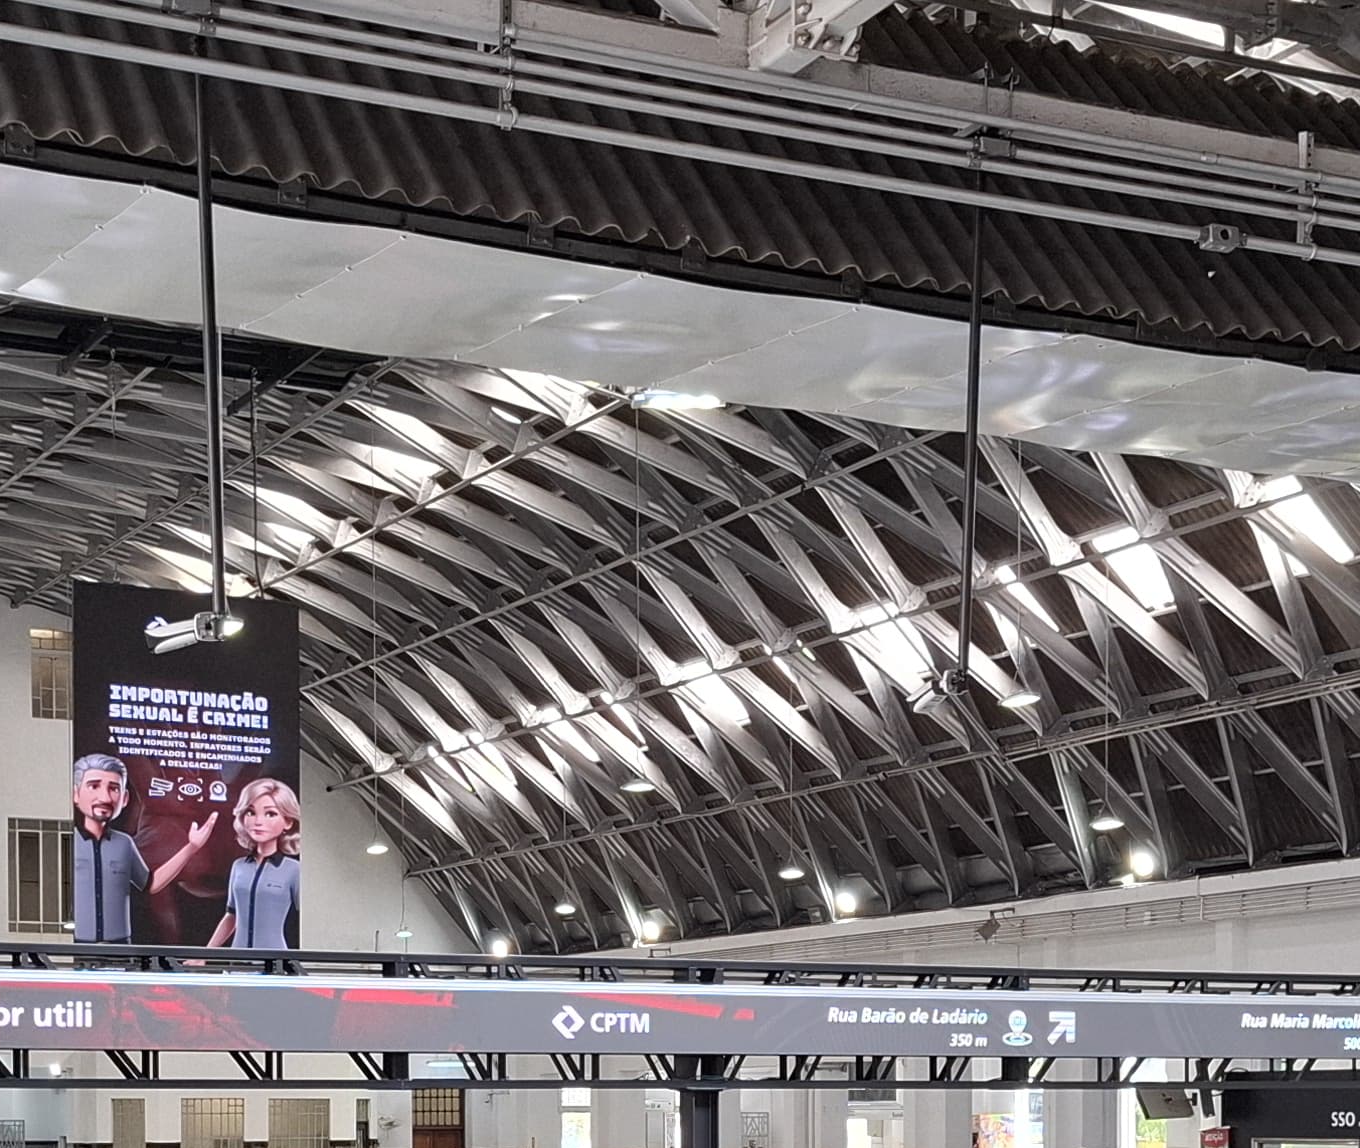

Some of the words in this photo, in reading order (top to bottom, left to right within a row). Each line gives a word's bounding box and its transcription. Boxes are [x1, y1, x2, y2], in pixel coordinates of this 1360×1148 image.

[110, 684, 268, 712] IMPORTUNAÇÃO
[108, 704, 183, 723] SEXUAL
[187, 706, 198, 723] É
[202, 711, 268, 729] CRIME!
[108, 726, 137, 734] TRENS
[139, 727, 144, 735] E
[146, 728, 188, 739] ESTAÇÕES
[191, 730, 207, 740] SÃO
[210, 733, 271, 744] MONITORADOS
[118, 737, 141, 745] TODO
[144, 739, 188, 748] MOMENTO.
[190, 741, 241, 752] INFRATORES
[244, 744, 271, 754] SERÃO
[119, 747, 186, 758] IDENTIFICADOS
[196, 752, 261, 763] ENCAMINHADOS
[168, 760, 222, 770] DELEGACIAS!
[34, 1000, 93, 1028] utili
[828, 1006, 857, 1022] Rua
[861, 1007, 906, 1023] Barão
[909, 1007, 928, 1024] de
[932, 1008, 988, 1024] Ladário
[1241, 1013, 1267, 1028] Rua
[1270, 1013, 1309, 1029] Maria
[590, 1012, 650, 1034] CPTM
[949, 1033, 972, 1047] 350
[975, 1036, 988, 1047] m
[1331, 1112, 1356, 1127] SSO
